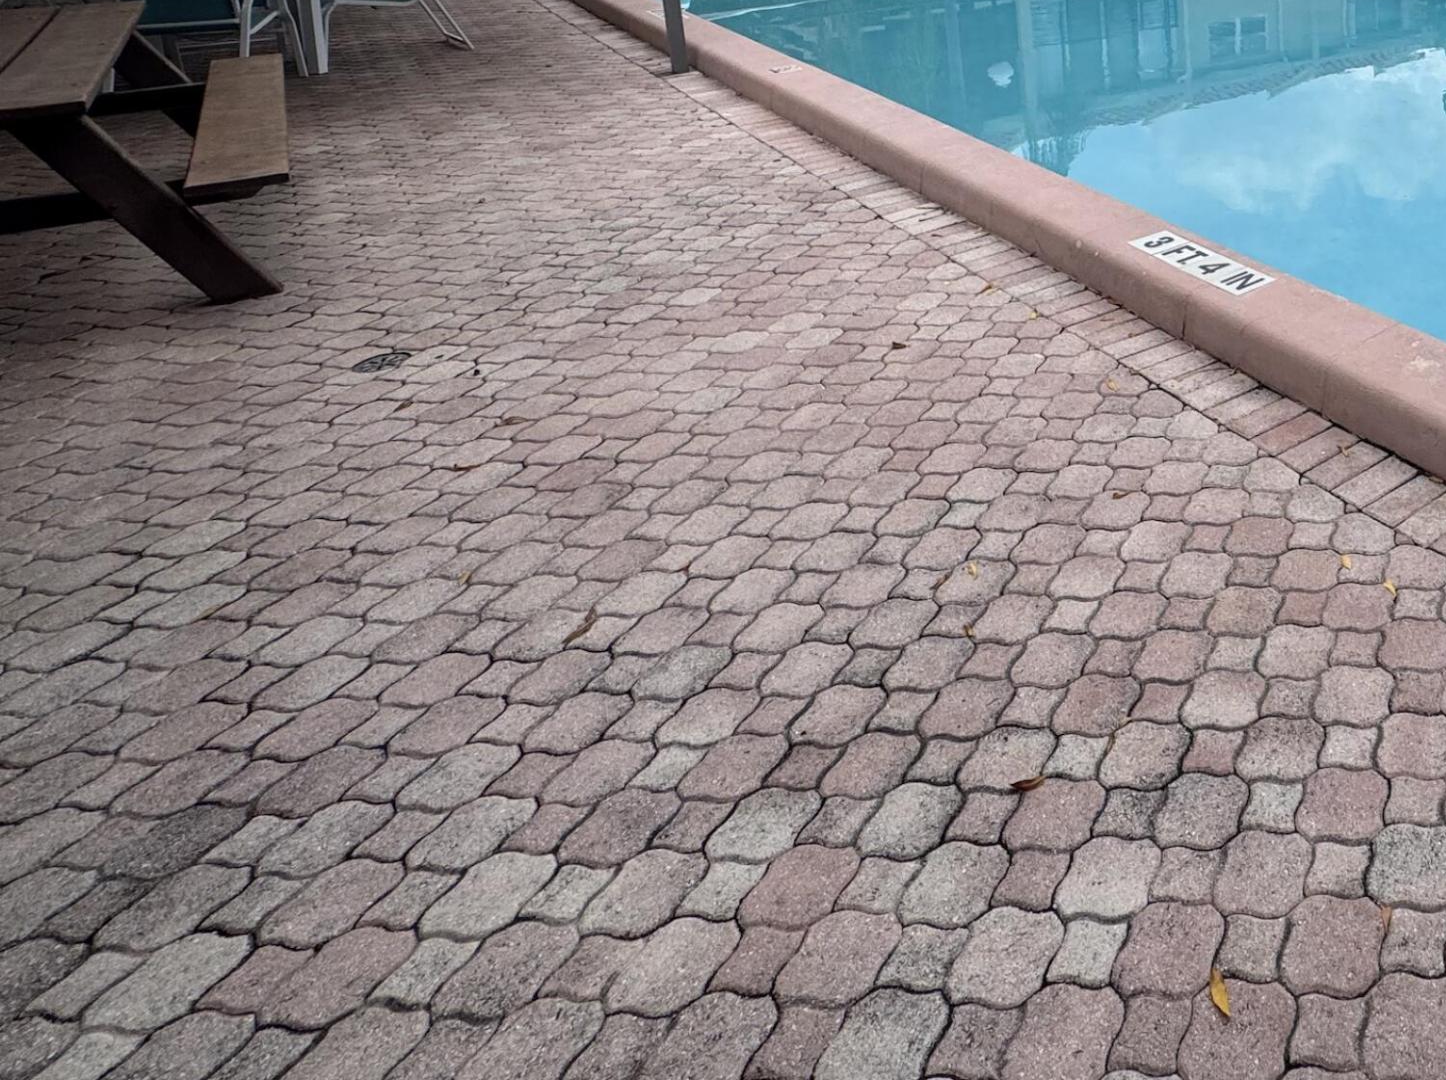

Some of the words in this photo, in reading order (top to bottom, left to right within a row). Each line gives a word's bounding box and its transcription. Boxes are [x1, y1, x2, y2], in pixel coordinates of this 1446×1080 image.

[1144, 236, 1174, 248] 3
[1198, 262, 1231, 275] 4
[1220, 271, 1265, 291] IN
